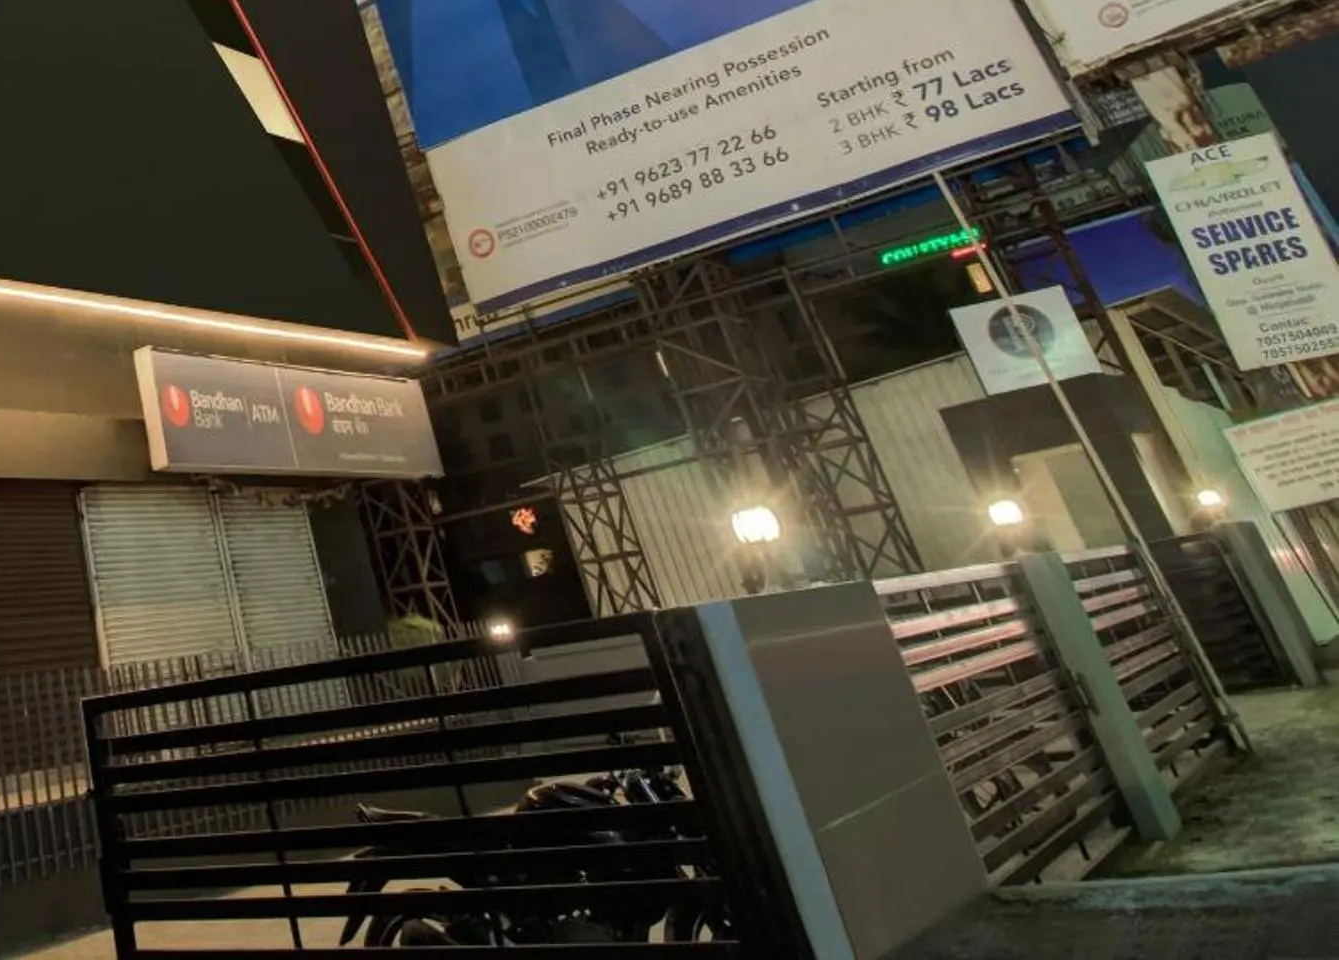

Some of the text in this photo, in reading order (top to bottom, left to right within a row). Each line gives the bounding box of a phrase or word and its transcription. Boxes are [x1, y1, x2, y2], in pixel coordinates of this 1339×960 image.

[547, 28, 830, 148] Final Phase Nearing Possession
[586, 65, 802, 156] Ready-to-use Amenities
[817, 49, 955, 108] Starting from
[829, 118, 842, 134] 2
[846, 101, 890, 127] BHK
[912, 76, 943, 101] 77
[952, 59, 1012, 88] Lacs
[839, 139, 853, 156] 3
[857, 123, 903, 149] BHK
[924, 99, 959, 123] 98
[964, 82, 1025, 110] Lacs
[1190, 144, 1233, 166] ACE
[597, 125, 776, 200] +91 9623 77 22 66
[607, 146, 790, 222] +91 9689 88 33 66
[190, 388, 280, 425] Bandhan ATM
